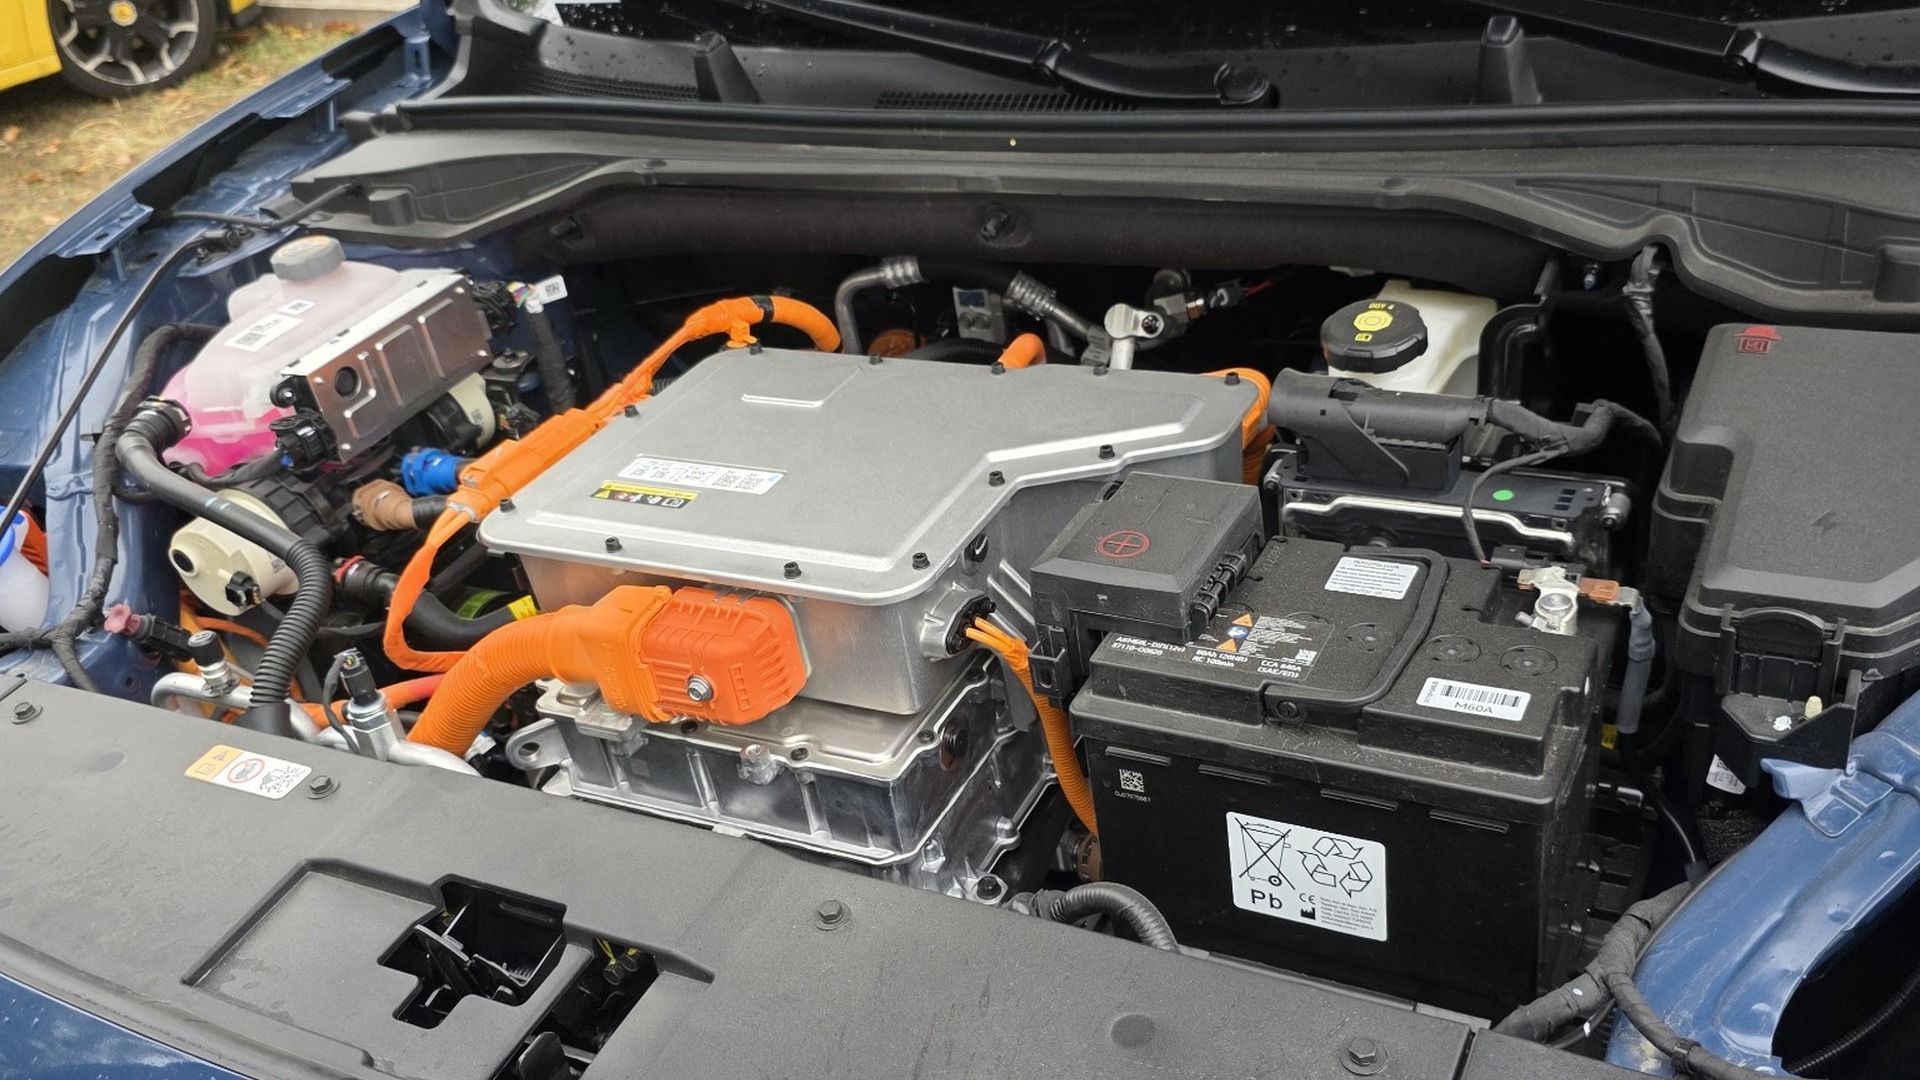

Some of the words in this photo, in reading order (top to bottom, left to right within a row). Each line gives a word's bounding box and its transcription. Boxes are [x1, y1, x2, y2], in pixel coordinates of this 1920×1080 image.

[1261, 660, 1278, 668] CCA
[1454, 702, 1493, 714] M60A
[1251, 888, 1283, 910] Pb
